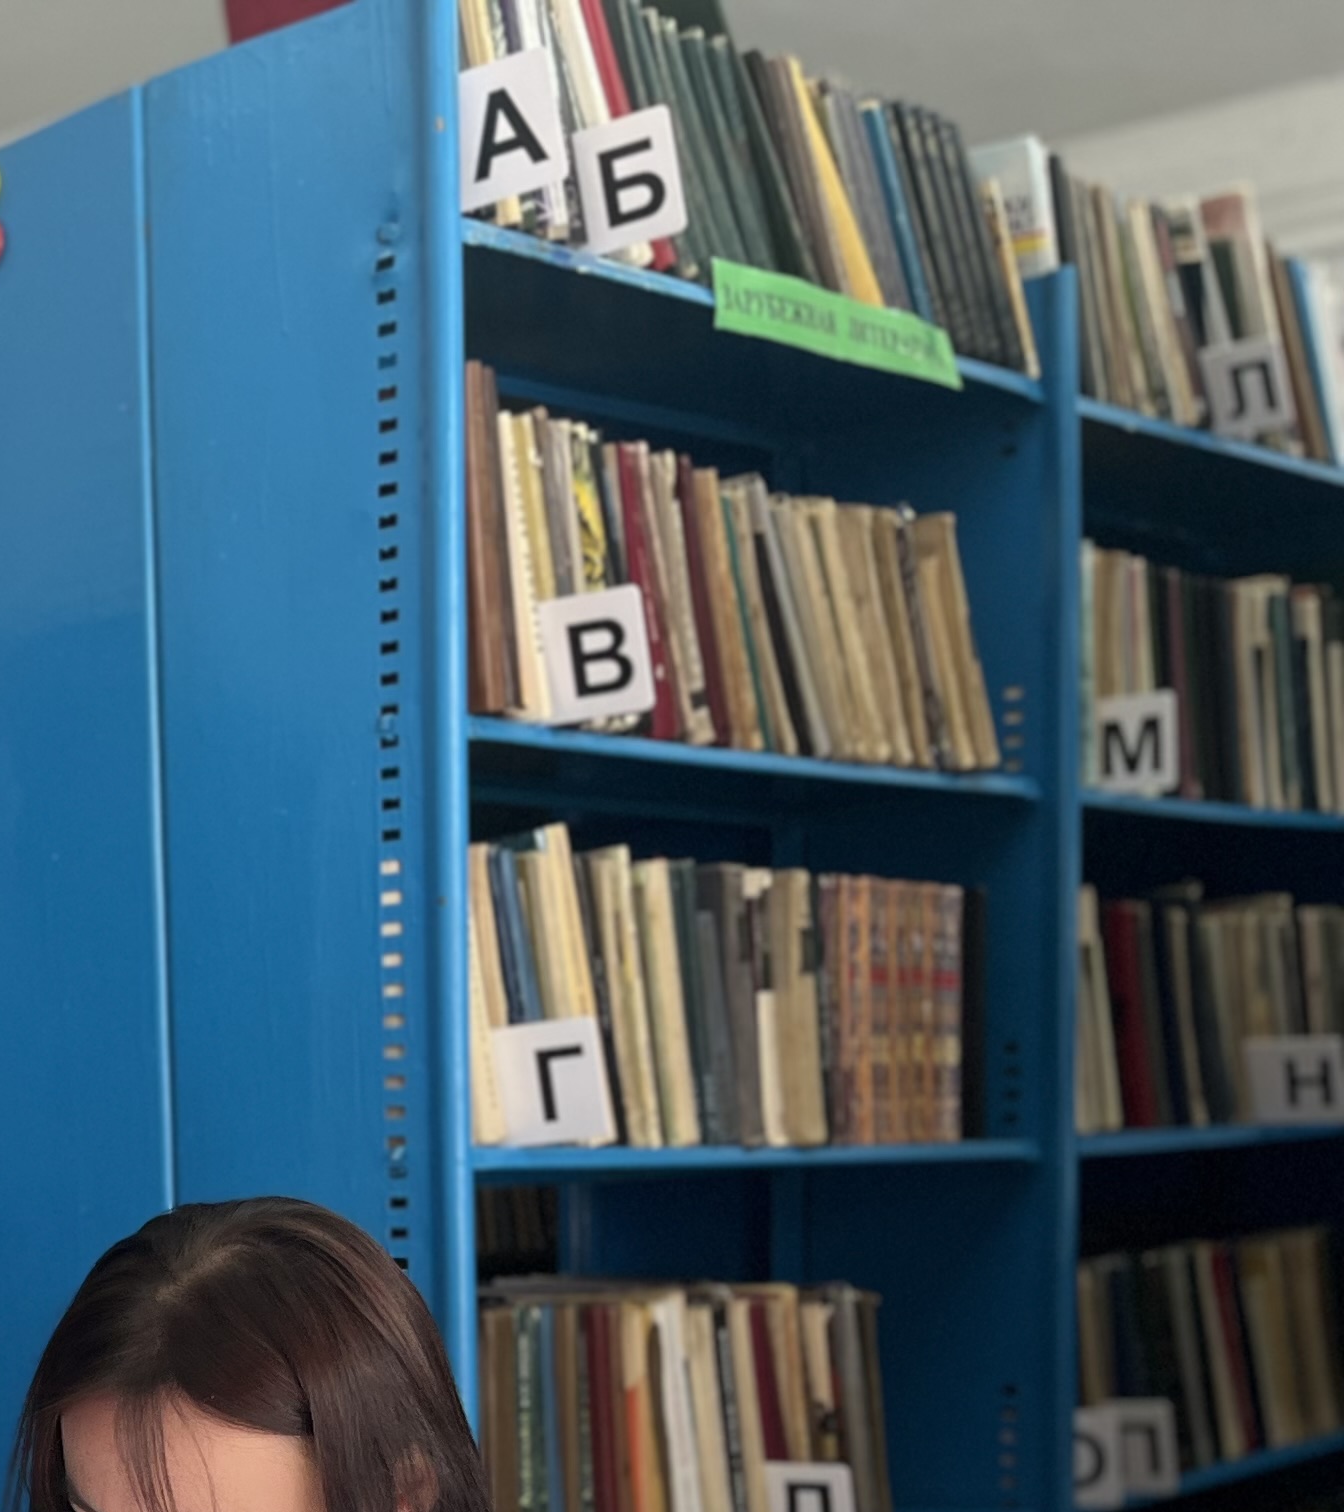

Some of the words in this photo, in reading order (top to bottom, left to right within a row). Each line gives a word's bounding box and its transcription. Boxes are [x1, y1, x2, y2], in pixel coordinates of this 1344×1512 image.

[474, 87, 550, 183] А
[598, 136, 666, 229] Б
[1228, 359, 1277, 420] Л
[566, 618, 634, 699] В
[1102, 715, 1162, 778] М
[535, 1043, 584, 1123] Г
[1283, 1055, 1334, 1107] Н
